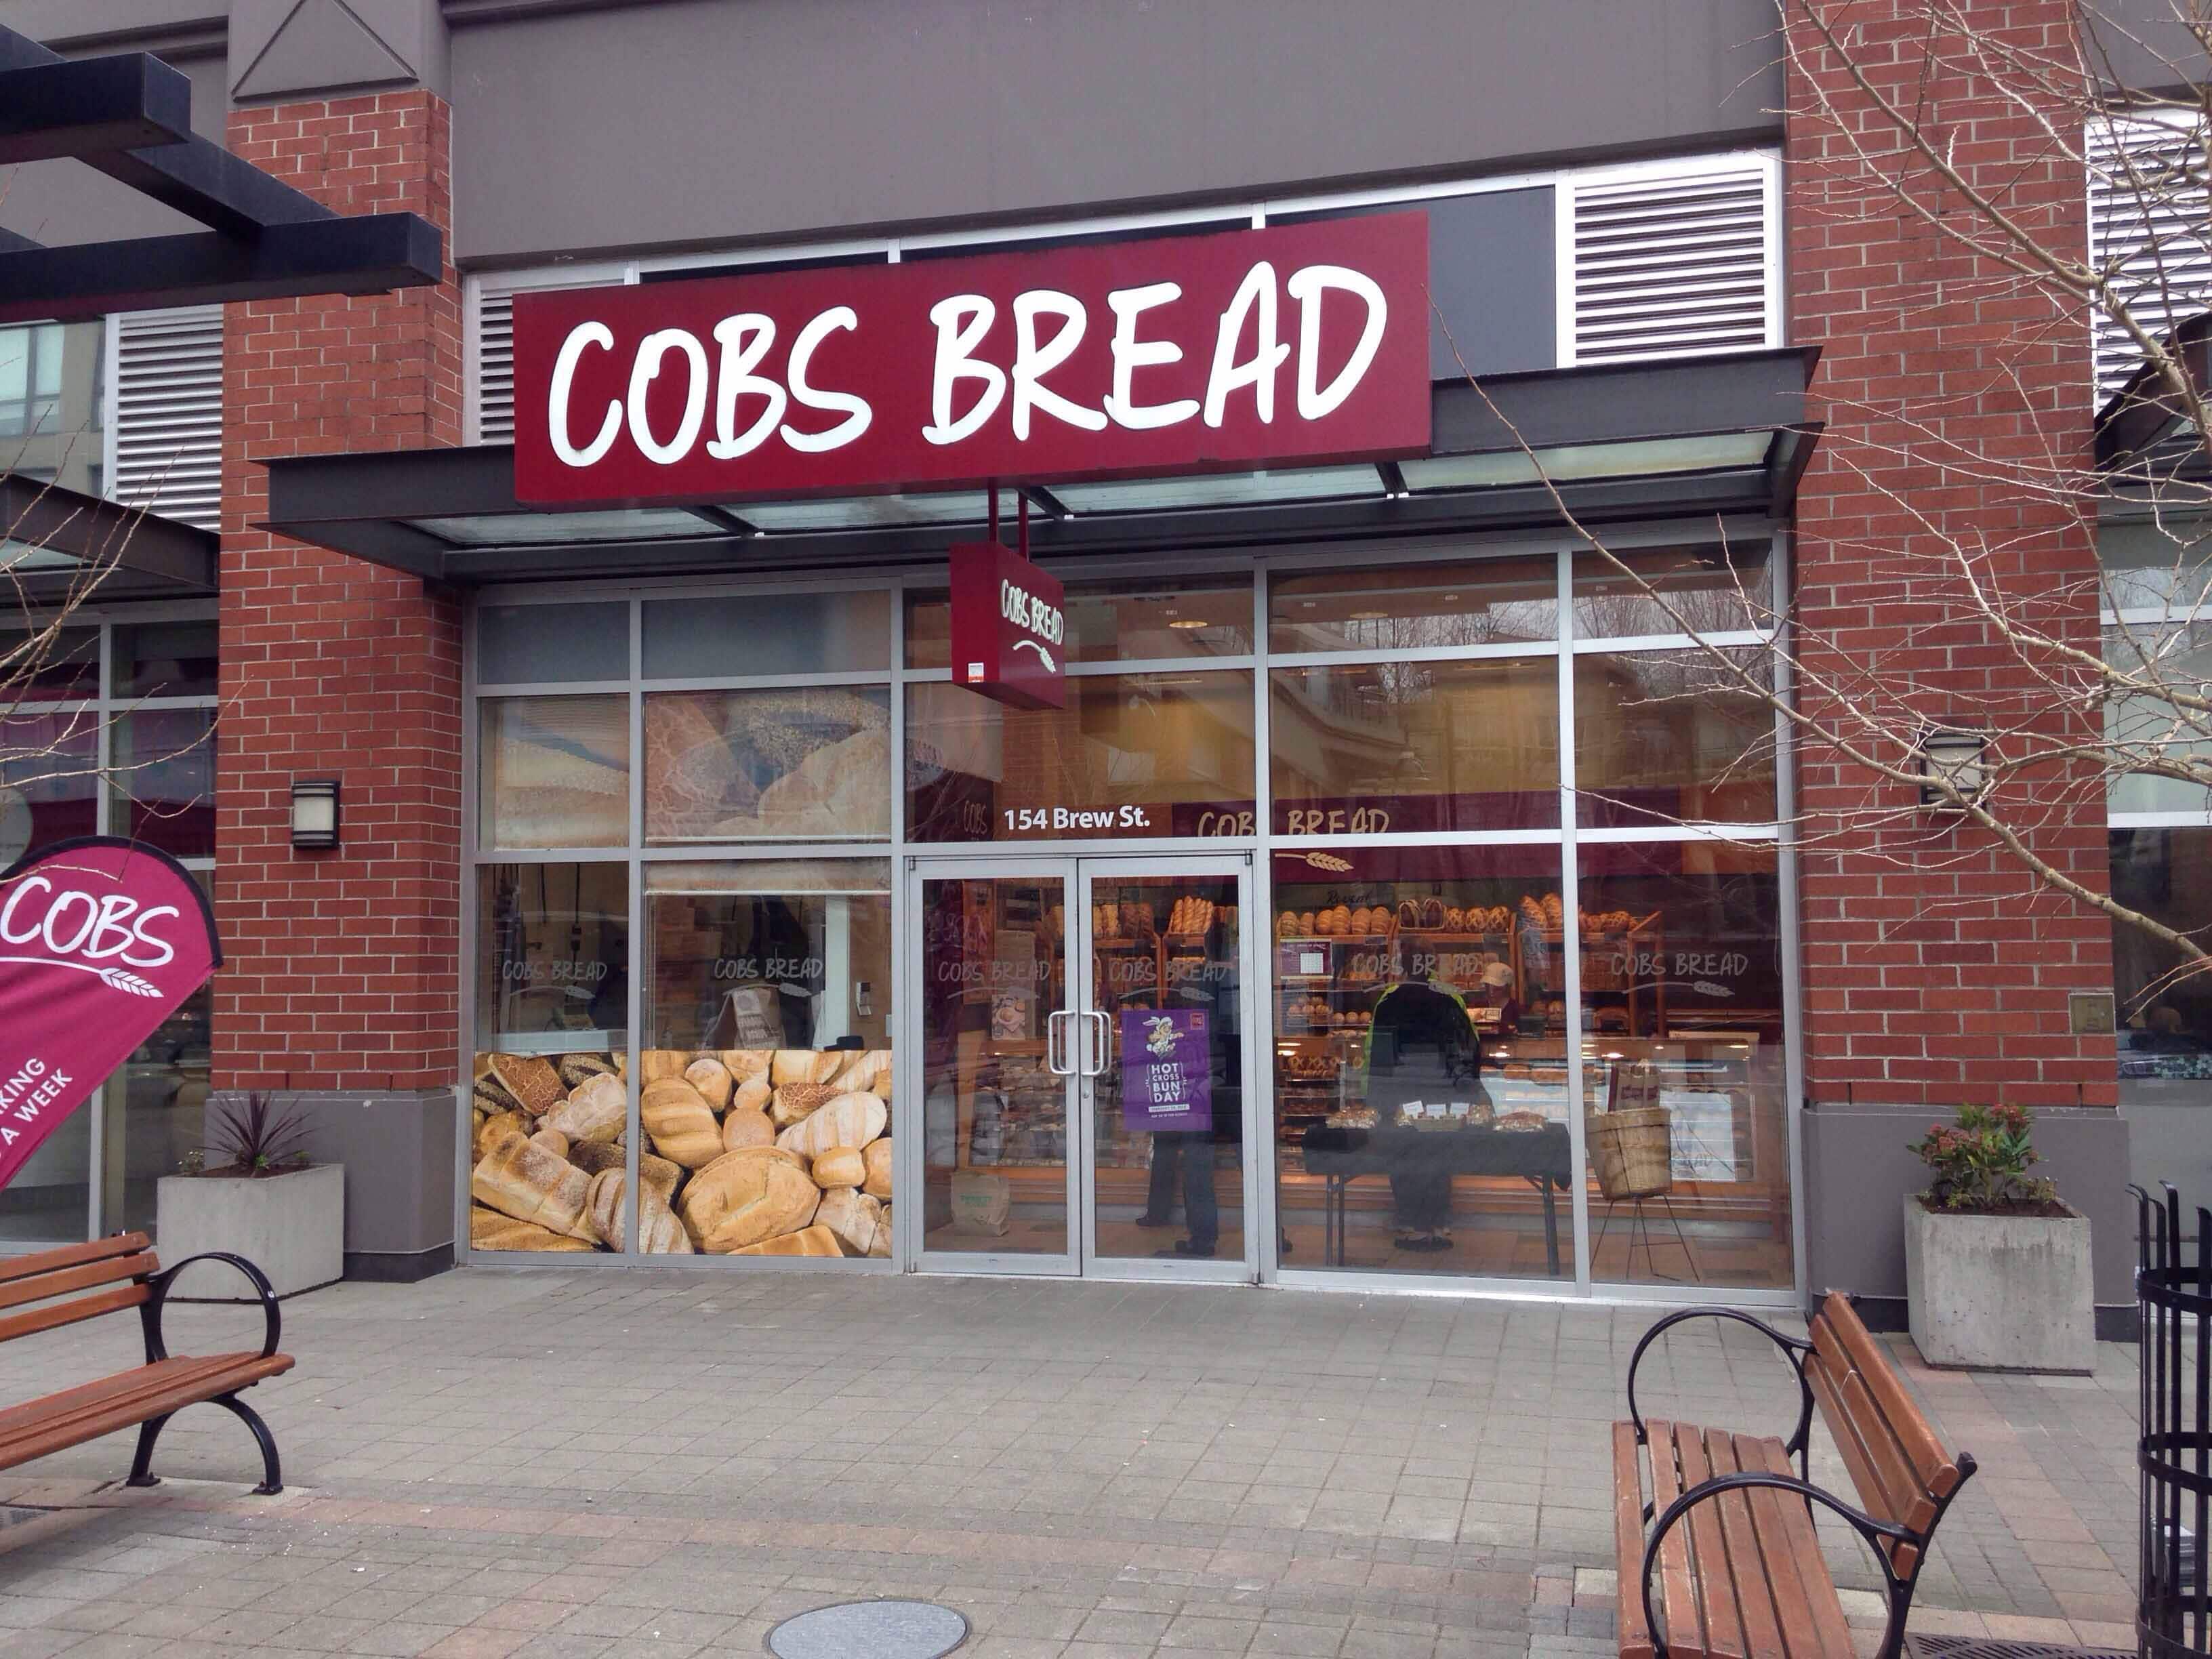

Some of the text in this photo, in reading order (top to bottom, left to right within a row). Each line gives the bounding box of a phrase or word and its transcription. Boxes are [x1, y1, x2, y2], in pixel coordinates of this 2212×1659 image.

[548, 260, 1389, 467] COBS BREAD
[1001, 579, 1064, 645] COBS BREAD
[1004, 804, 1151, 830] 154 Brew St.
[1197, 811, 1256, 838] COB
[0, 876, 180, 967] COBS
[502, 959, 607, 981] COBS BREAD
[714, 958, 823, 980] COBS BREAD
[938, 958, 1051, 982] COBS BREAD
[1108, 958, 1227, 983] COBS BREAD
[1351, 951, 1404, 976] COBS
[1610, 953, 1748, 976] COBS BREAD
[1151, 1063, 1179, 1074] HOT
[1152, 1073, 1179, 1082] CROSS
[0, 1058, 45, 1115] KING
[1153, 1082, 1180, 1092] BUN
[1154, 1091, 1181, 1103] DAY
[1, 1067, 73, 1146] A WEEK
